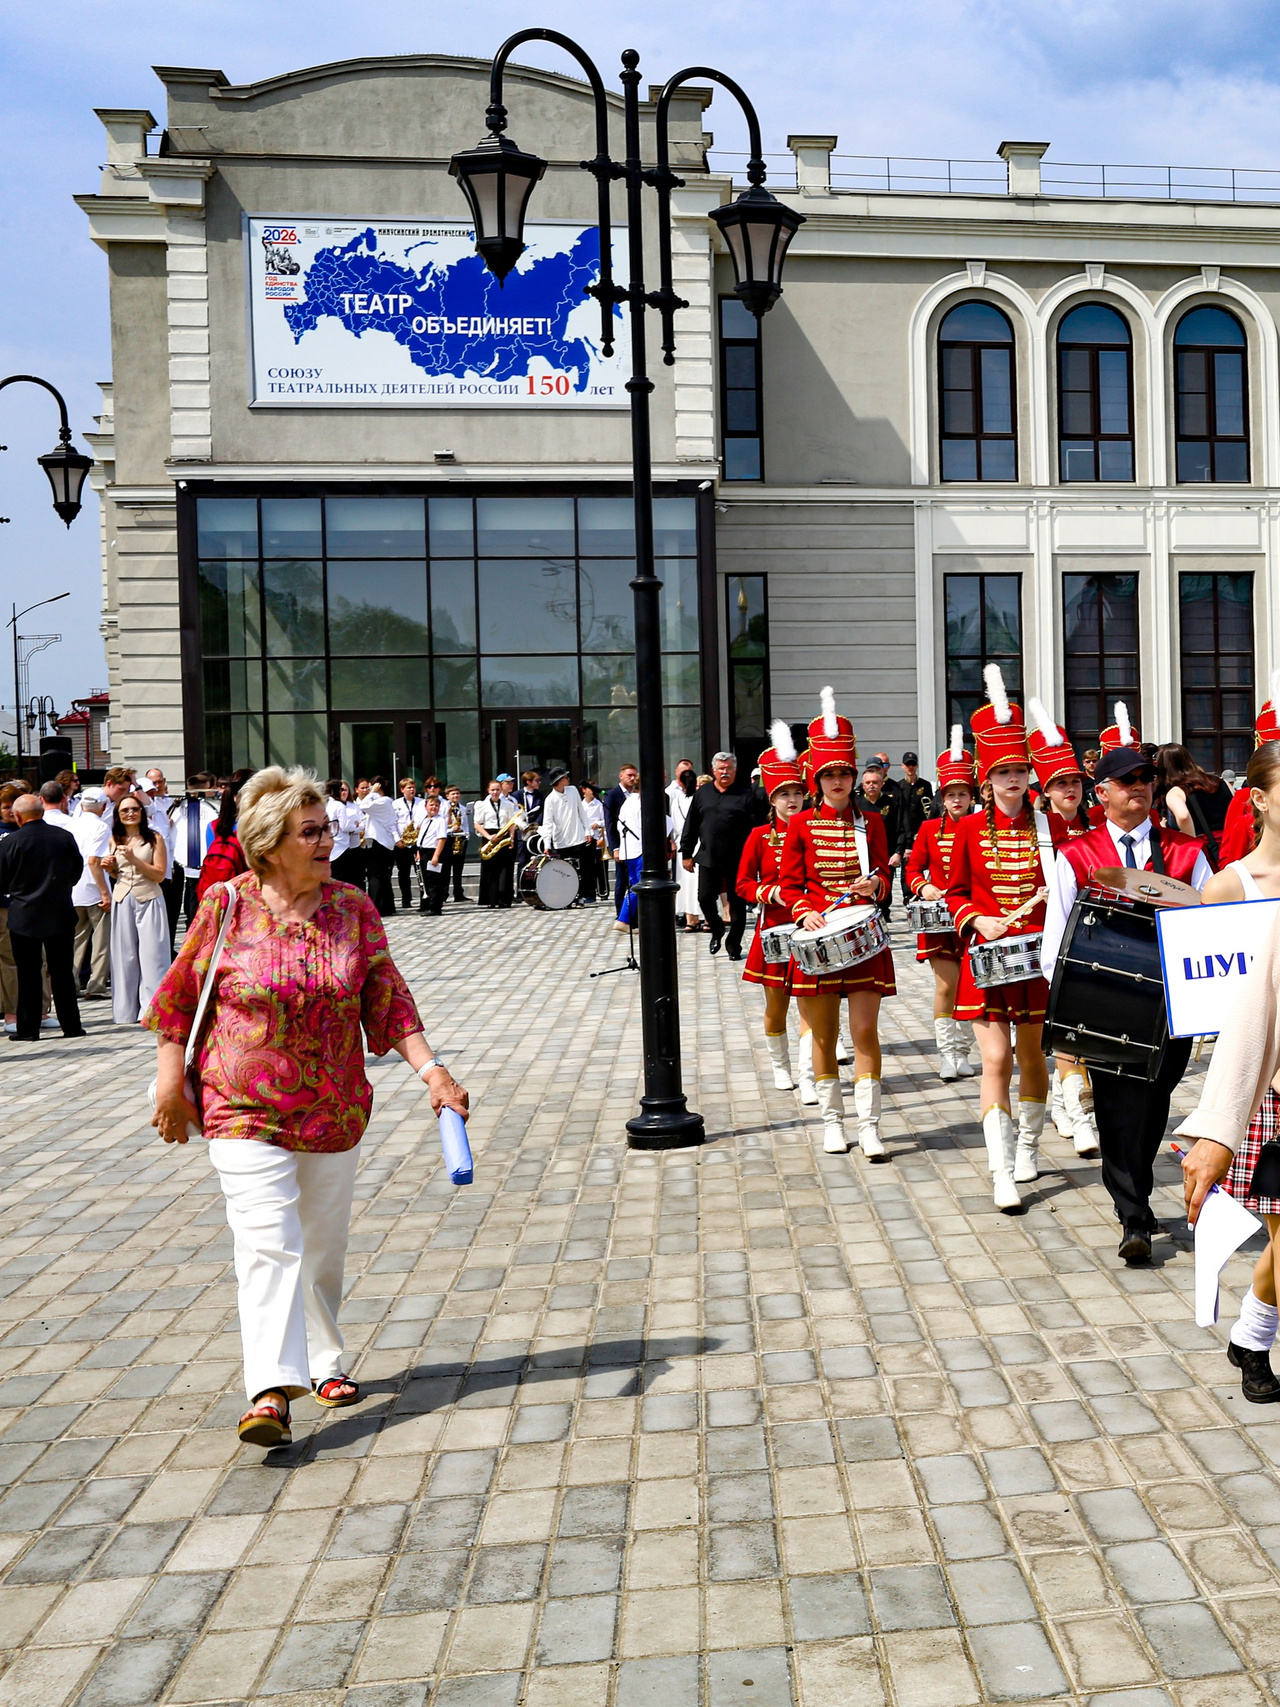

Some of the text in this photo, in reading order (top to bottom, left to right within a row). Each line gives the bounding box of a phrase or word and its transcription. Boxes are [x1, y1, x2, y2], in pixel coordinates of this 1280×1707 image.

[263, 229, 297, 241] 2026
[422, 229, 469, 237] ДРАМАТИЧЕСКИЙ
[340, 294, 413, 315] ТЕАТР
[412, 316, 552, 338] ОБЪЕДИНЯЕТ!
[268, 367, 323, 379] СОЮЗУ
[267, 375, 615, 396] ТЕАТРАЛЬНЫХ ДЕЯТЕЛЕЙ РОССИИ 150 лет
